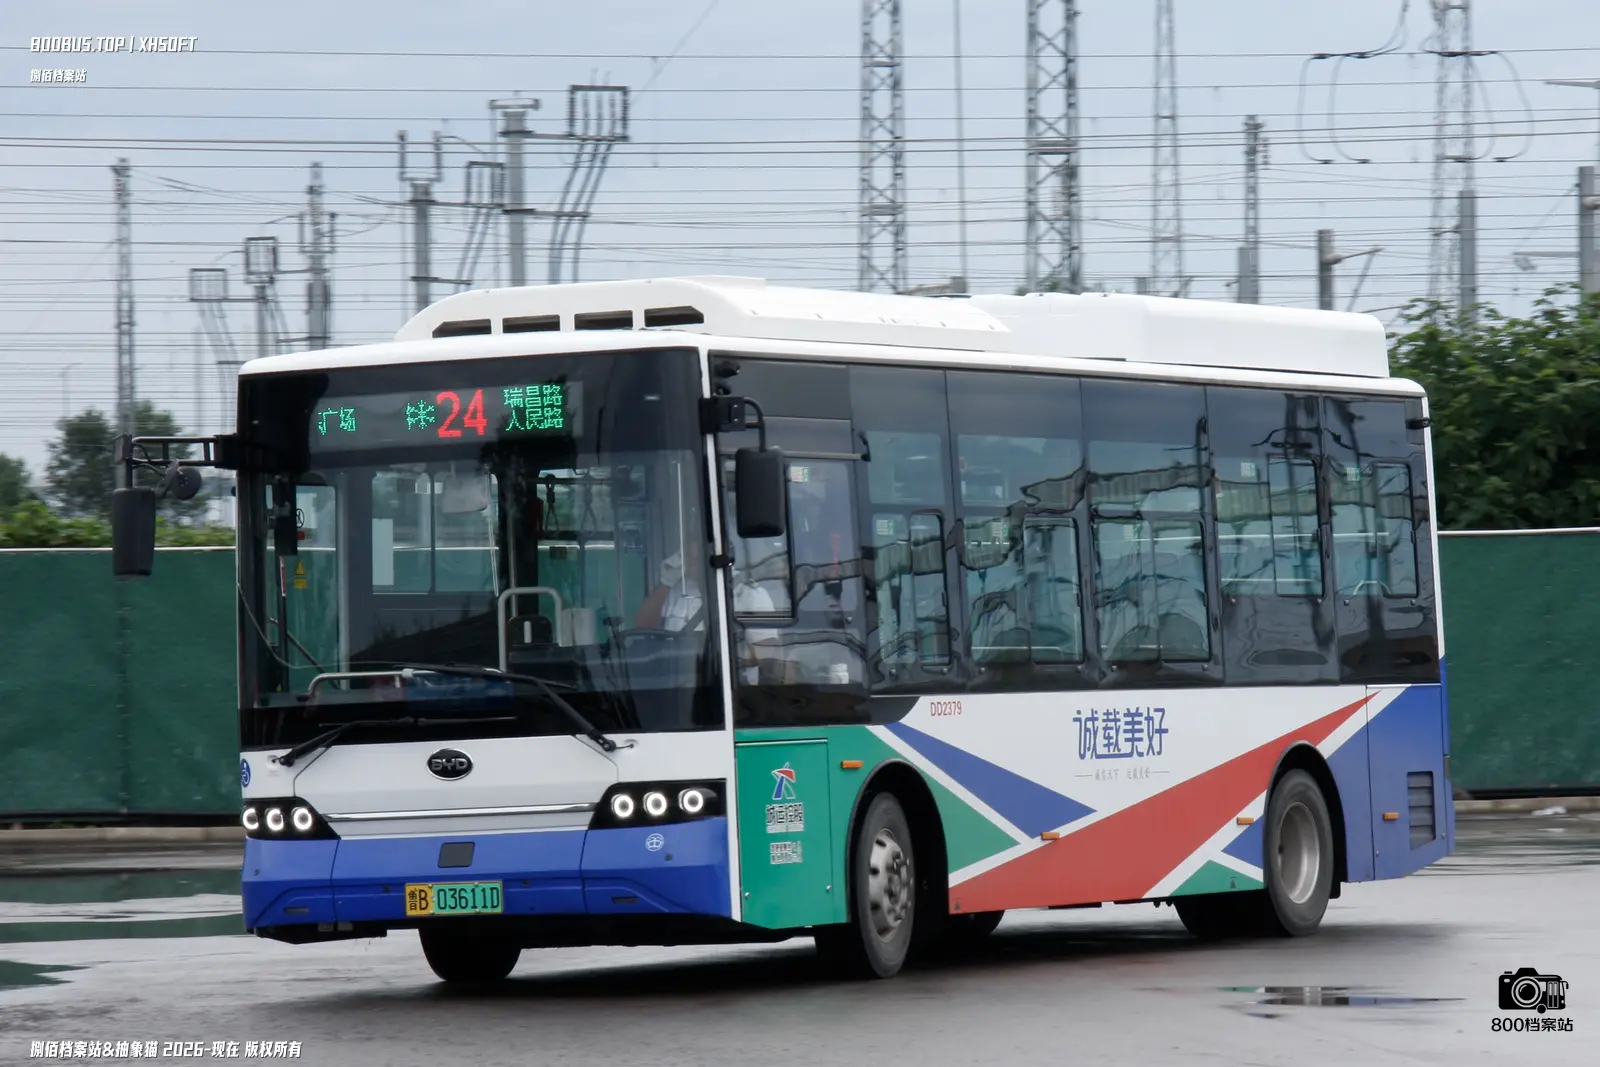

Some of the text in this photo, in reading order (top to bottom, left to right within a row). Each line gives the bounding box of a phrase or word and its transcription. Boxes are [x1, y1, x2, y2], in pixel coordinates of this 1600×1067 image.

[503, 384, 562, 408] 瑞昌路
[436, 388, 488, 438] 24
[505, 406, 564, 431] 人民路
[930, 700, 962, 717] DD2379
[1072, 706, 1169, 760] 诚载美好
[431, 757, 469, 771] BYD
[437, 886, 500, 910] 03611D
